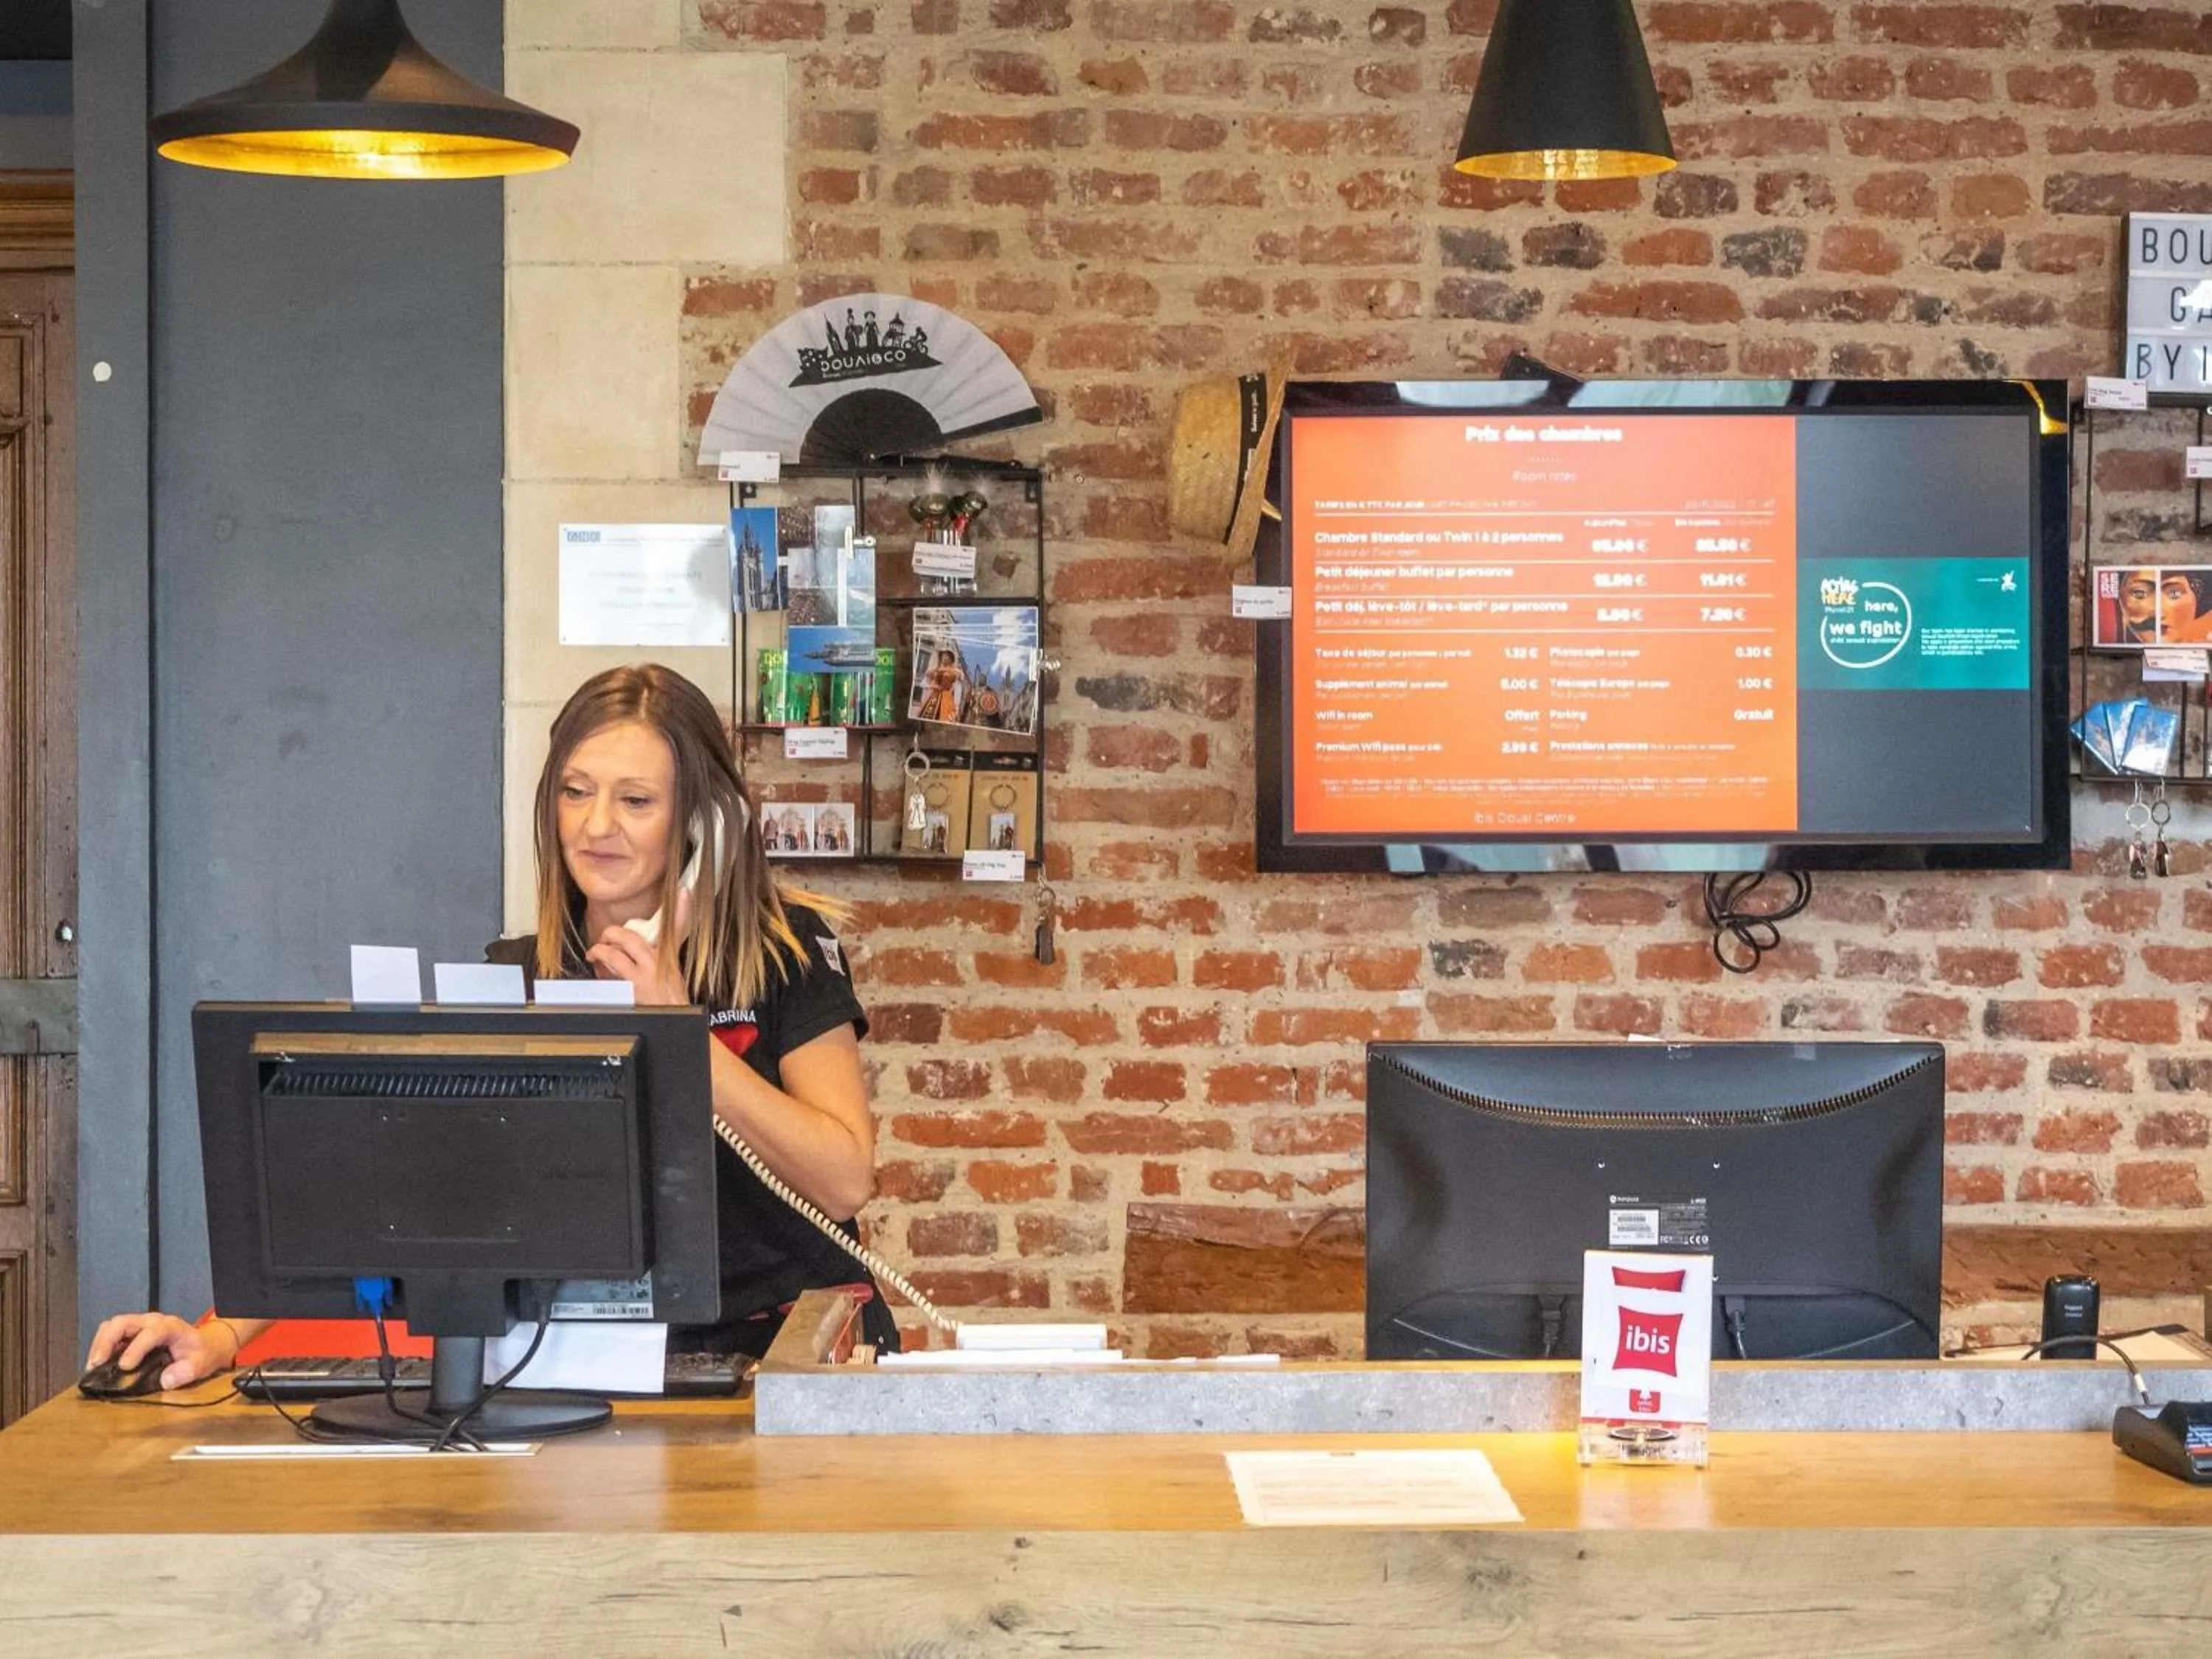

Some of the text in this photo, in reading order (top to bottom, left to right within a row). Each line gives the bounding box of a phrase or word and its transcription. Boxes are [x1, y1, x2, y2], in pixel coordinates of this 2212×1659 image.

[2136, 344, 2182, 380] BY
[1465, 425, 1622, 442] Prix des chambres
[1315, 532, 1368, 543] Chambre
[1371, 532, 1423, 543] Standard
[1426, 534, 1441, 543] ou
[1444, 532, 1472, 543] Twin
[1501, 533, 1564, 545] personnes
[1315, 566, 1514, 580] Petit déjeuner buffet par personne
[1315, 601, 1342, 612] Petit
[1491, 603, 1510, 614] par
[1512, 603, 1568, 614] personne
[1865, 600, 1899, 613] here,
[1829, 620, 1902, 637] we fight
[1342, 648, 1354, 658] de
[1504, 709, 1540, 721] Offert
[1549, 709, 1587, 721] Parking
[1733, 709, 1774, 720] Gratuit
[709, 1009, 757, 1027] ABRINA
[1625, 1325, 1670, 1354] ibis
